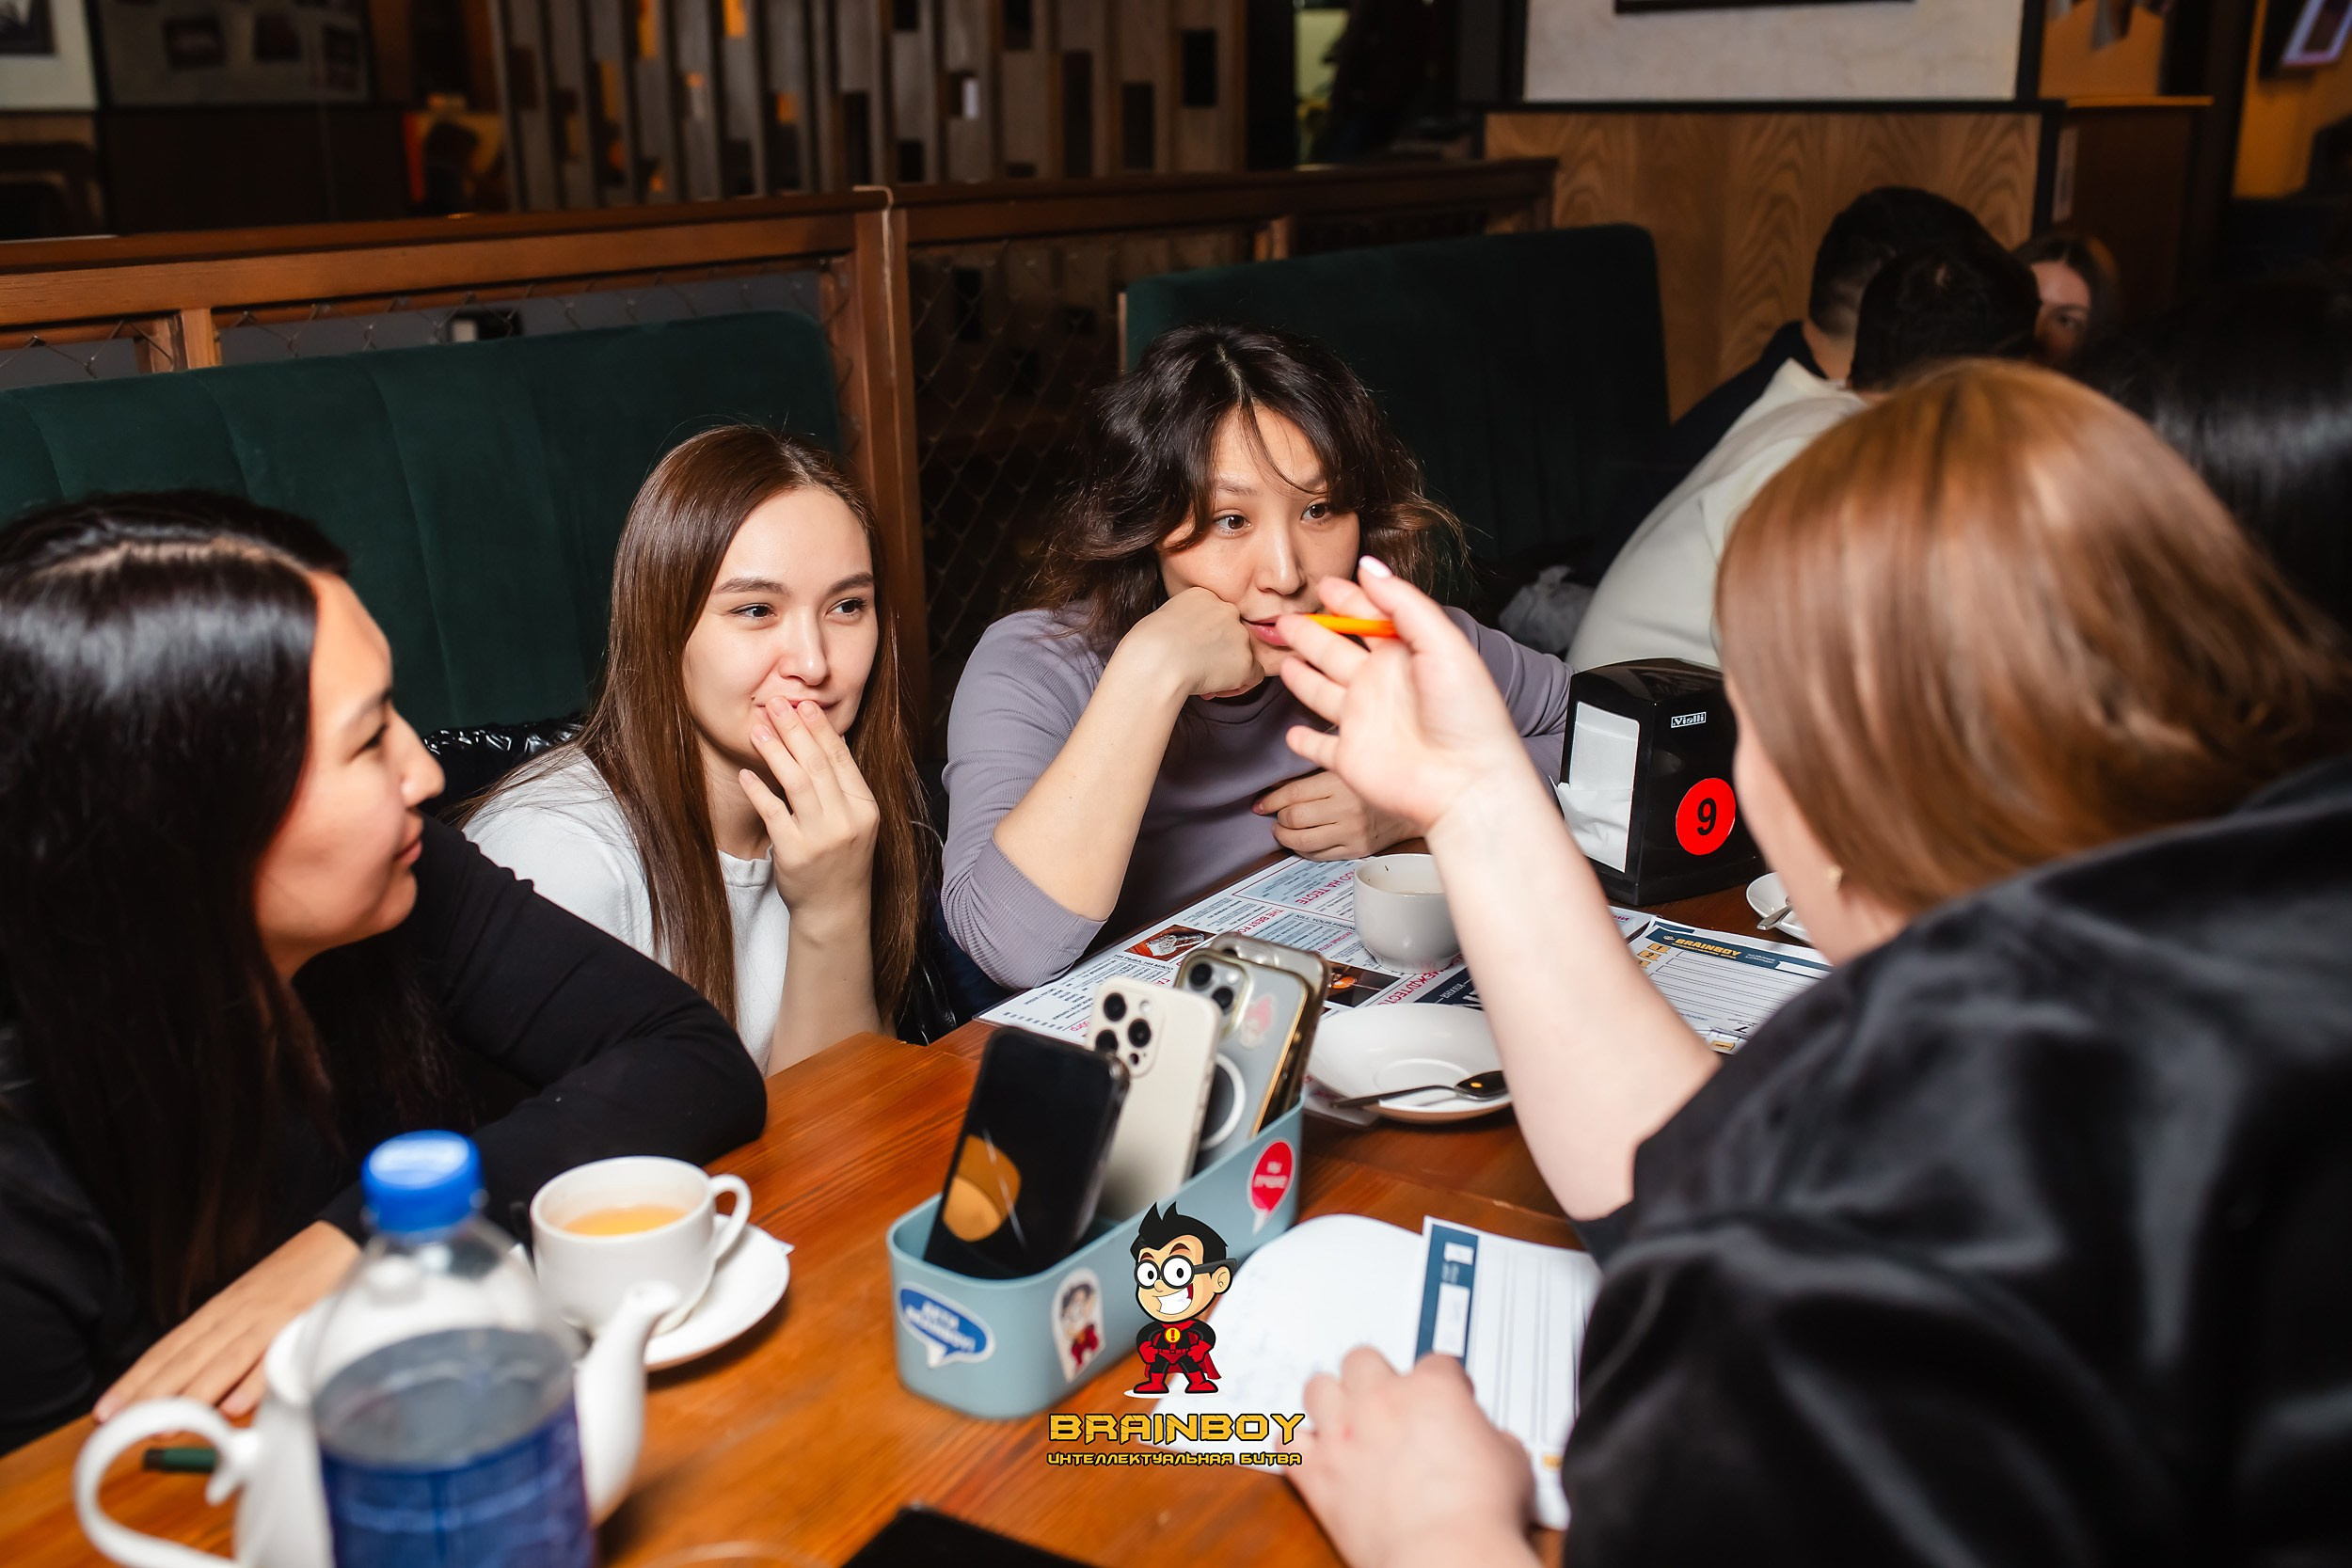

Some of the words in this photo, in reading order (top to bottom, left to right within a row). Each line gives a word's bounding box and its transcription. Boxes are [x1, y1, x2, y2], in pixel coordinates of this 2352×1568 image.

[1697, 798, 1717, 836] 9
[1325, 879, 1342, 889] НА
[1295, 888, 1330, 906] ТЕСТЕ
[1250, 914, 1271, 928] BEST
[1270, 909, 1284, 919] THE
[1675, 938, 1741, 958] BRAINBOY
